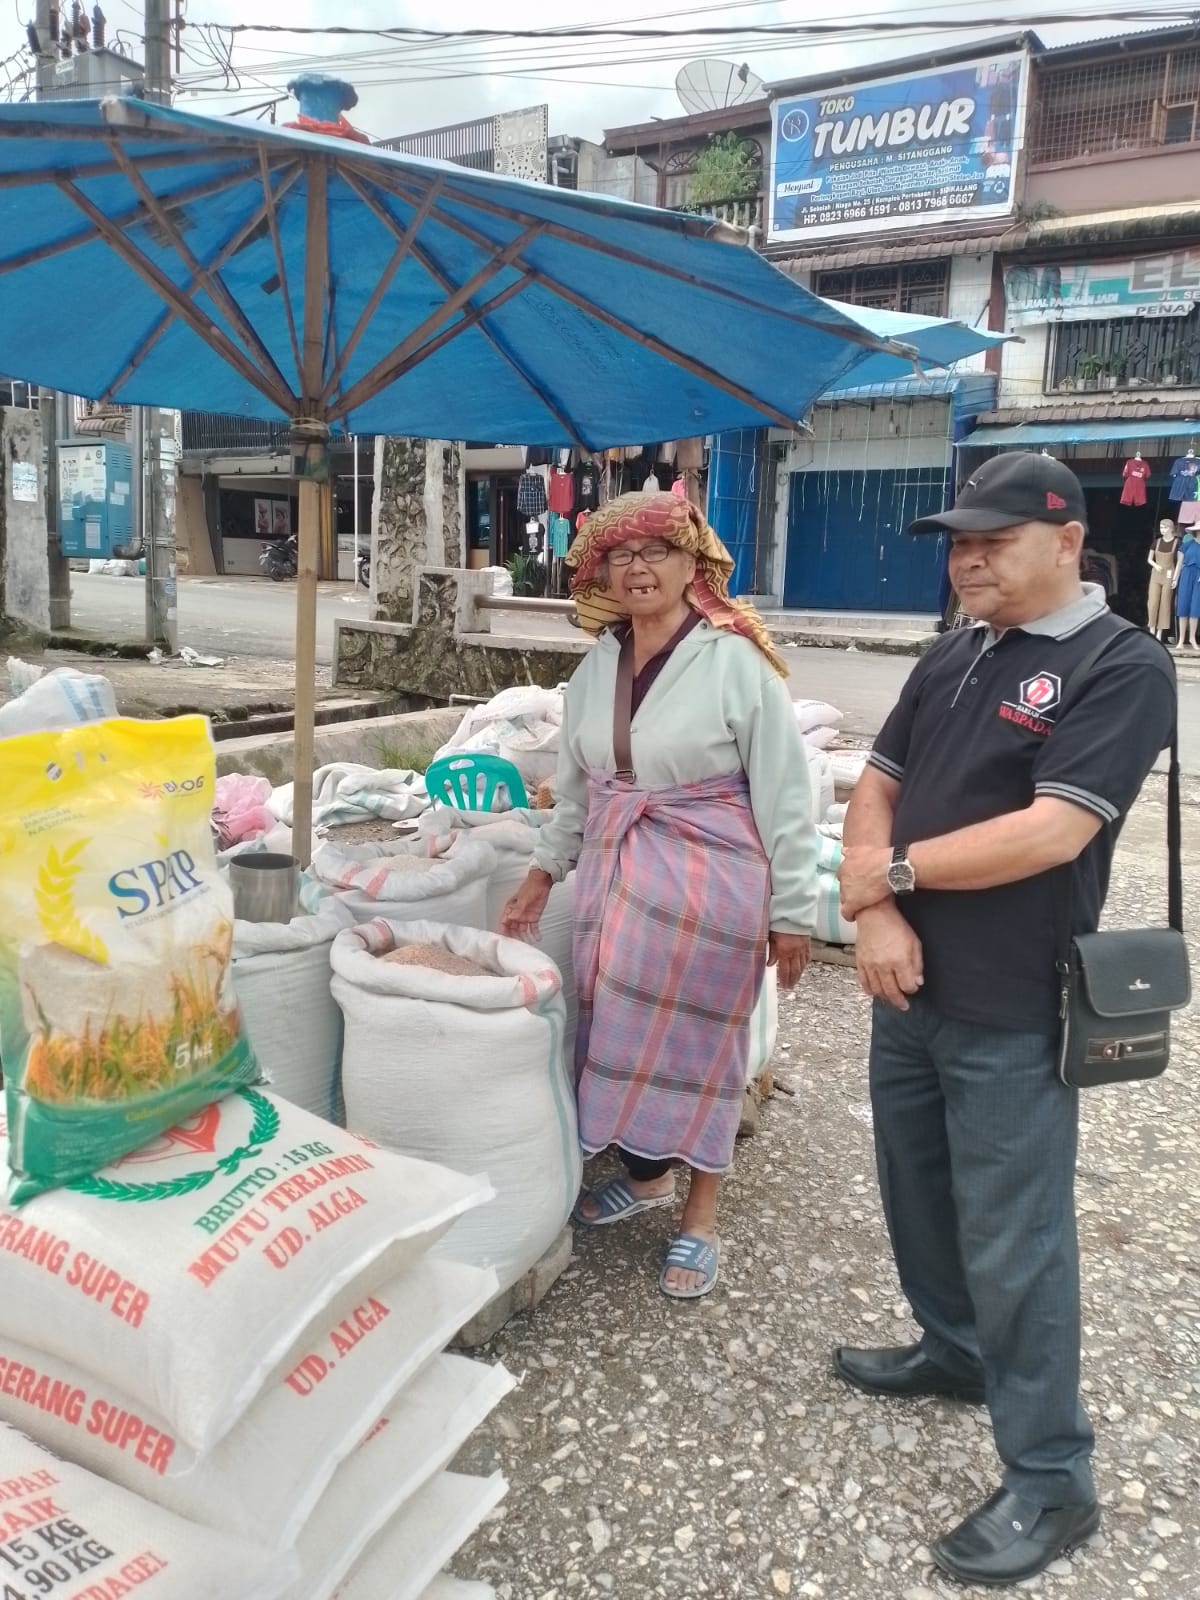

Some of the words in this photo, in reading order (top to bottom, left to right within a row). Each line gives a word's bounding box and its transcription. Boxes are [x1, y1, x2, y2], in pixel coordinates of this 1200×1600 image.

[814, 97, 975, 158] TUMBUR
[820, 96, 855, 117] TOKO
[829, 158, 879, 173] PENGUSAHA
[897, 145, 953, 161] SITANGGANG
[803, 213, 818, 225] HP.
[820, 210, 842, 223] 0823
[843, 206, 866, 219] 6966
[869, 203, 891, 217] 1591
[898, 199, 922, 213] 0813
[949, 192, 975, 206] 6667
[108, 849, 204, 919] SPAP
[187, 1207, 270, 1288] MUTU
[261, 1153, 375, 1213] TERJAMIN
[194, 1166, 278, 1236] BRUTTO
[282, 1148, 309, 1166] 15
[304, 1140, 335, 1158] KG
[262, 1226, 312, 1270] UD.
[307, 1185, 369, 1233] ALGA
[66, 1250, 151, 1329] SUPER
[284, 1354, 336, 1397] UD.
[329, 1296, 391, 1359] ALGA
[86, 1398, 177, 1476] SUPER
[32, 1518, 88, 1551] KG
[61, 1539, 115, 1574] KG
